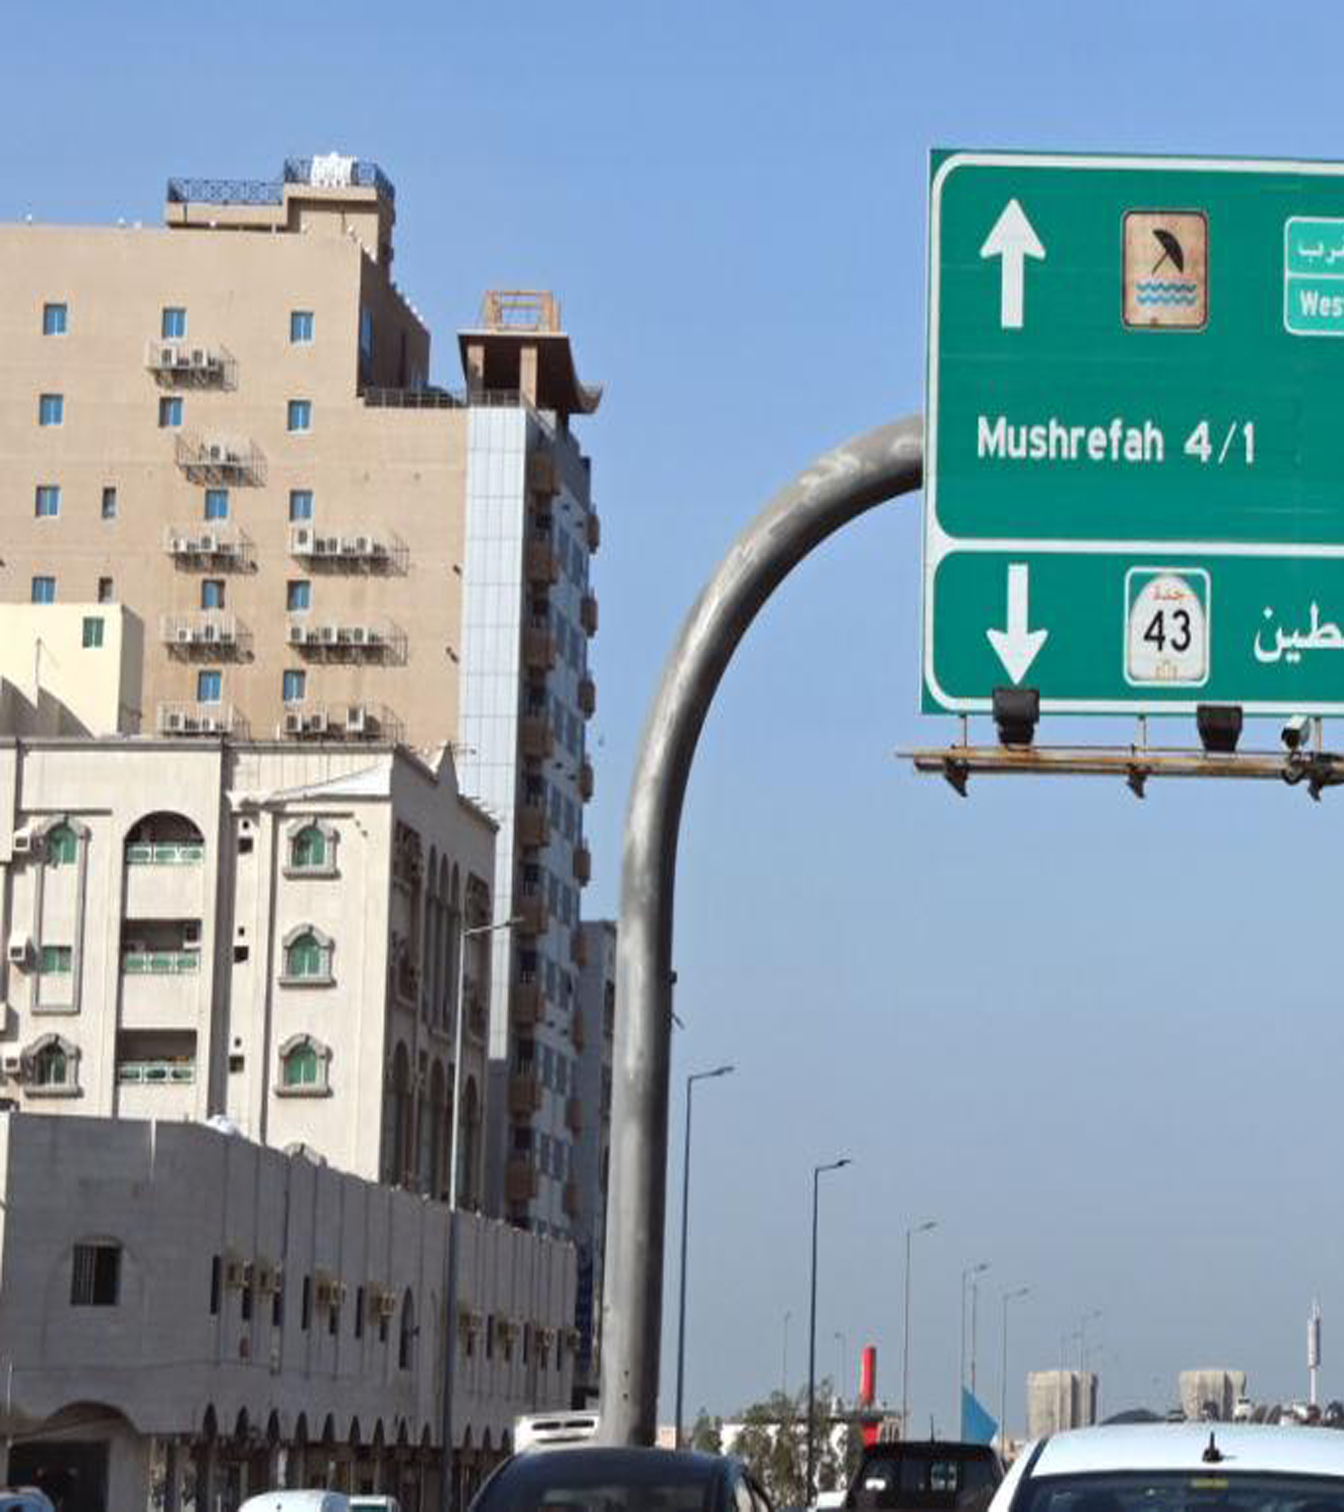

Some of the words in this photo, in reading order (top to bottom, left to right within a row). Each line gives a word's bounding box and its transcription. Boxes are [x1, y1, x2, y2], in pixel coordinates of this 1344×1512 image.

[977, 416, 1164, 461] Mushrefah
[1185, 421, 1254, 463] 4/1
[1143, 609, 1191, 652] 43
